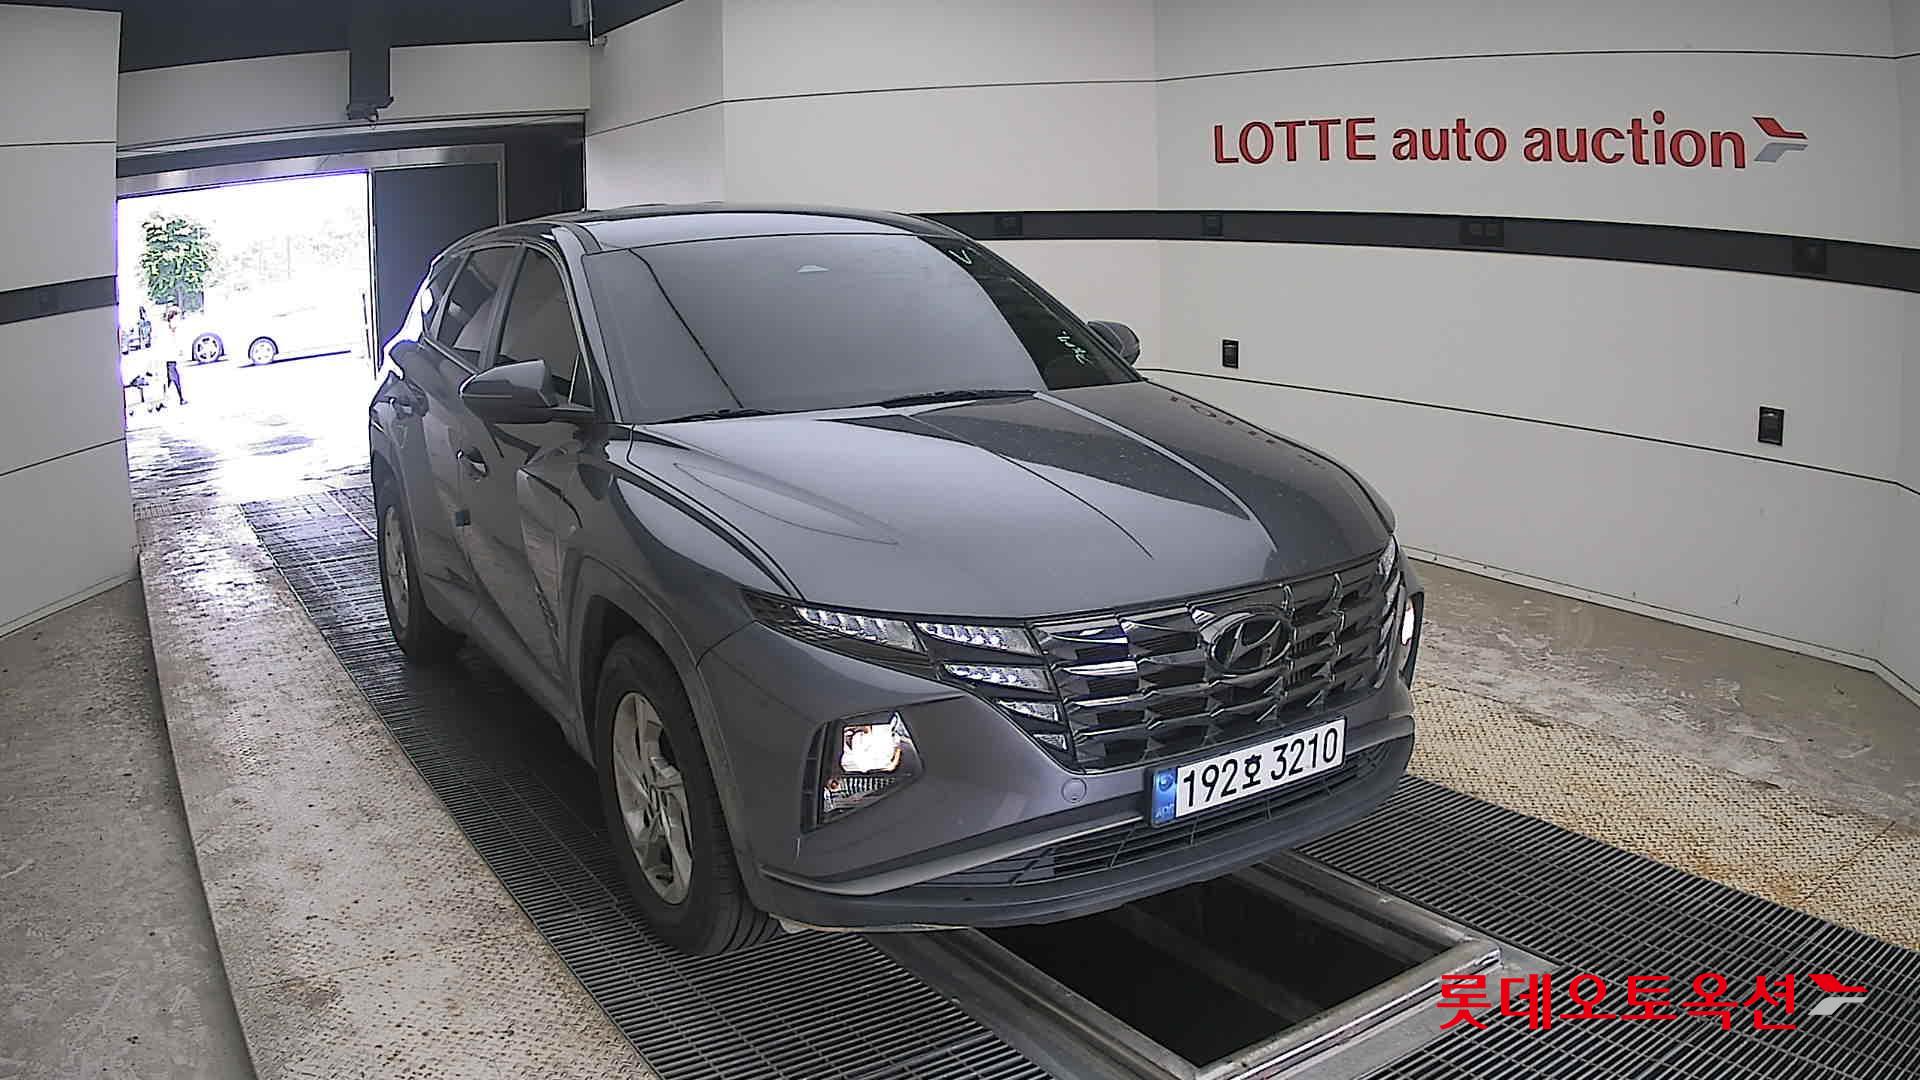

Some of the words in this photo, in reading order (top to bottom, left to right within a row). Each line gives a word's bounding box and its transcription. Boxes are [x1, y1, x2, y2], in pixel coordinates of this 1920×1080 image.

[1213, 117, 1376, 164] LOTTE
[1392, 118, 1507, 162] auto
[1523, 110, 1746, 169] auction
[1182, 753, 1263, 807] 192호
[1270, 727, 1338, 781] 3210
